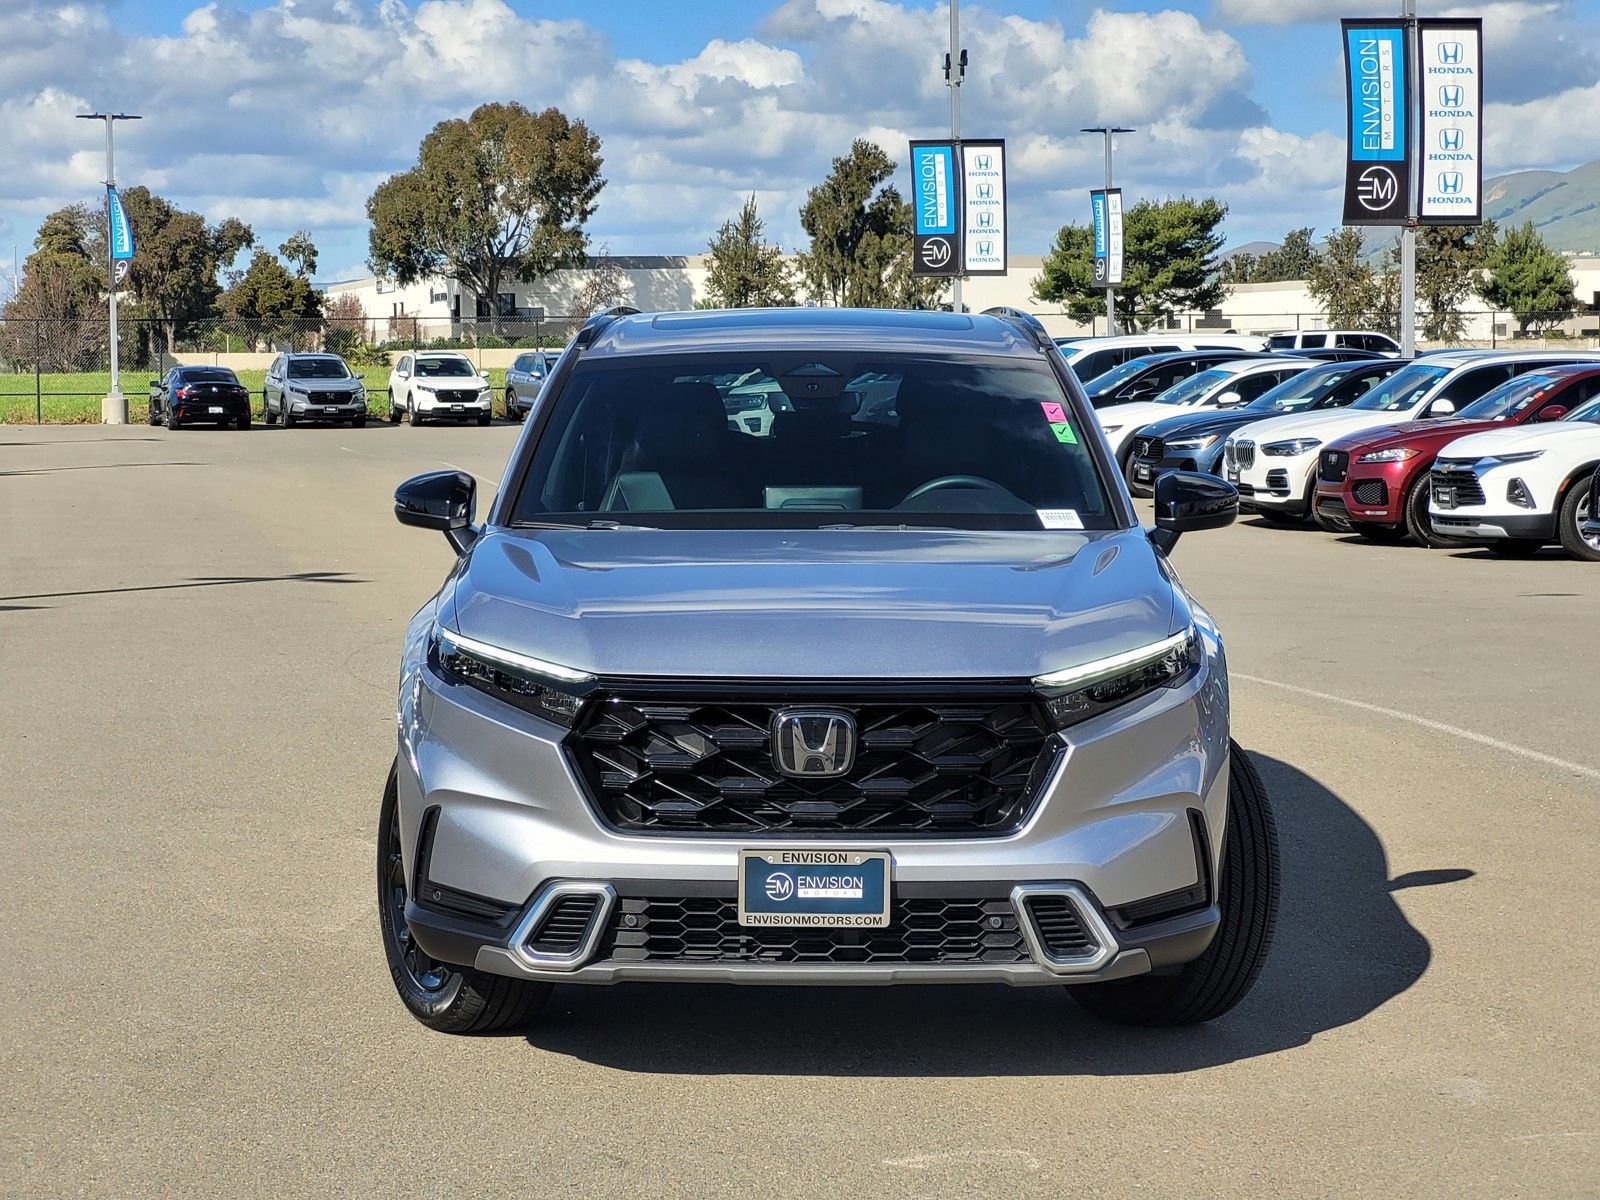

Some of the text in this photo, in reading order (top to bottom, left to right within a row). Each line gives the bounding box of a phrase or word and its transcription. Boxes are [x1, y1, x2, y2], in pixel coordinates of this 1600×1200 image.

[1359, 39, 1380, 150] ENVISION
[1381, 49, 1392, 141] MOTORS
[1428, 110, 1474, 118] HONDA
[1428, 153, 1474, 161] HONDA
[921, 153, 937, 228] ENVISION
[937, 160, 945, 221] MOTORS
[1427, 196, 1473, 204] HONDA
[782, 852, 848, 864] ENVISION
[797, 876, 863, 889] ENVISION
[746, 915, 883, 926] ENVISIONMOTORS.COM
